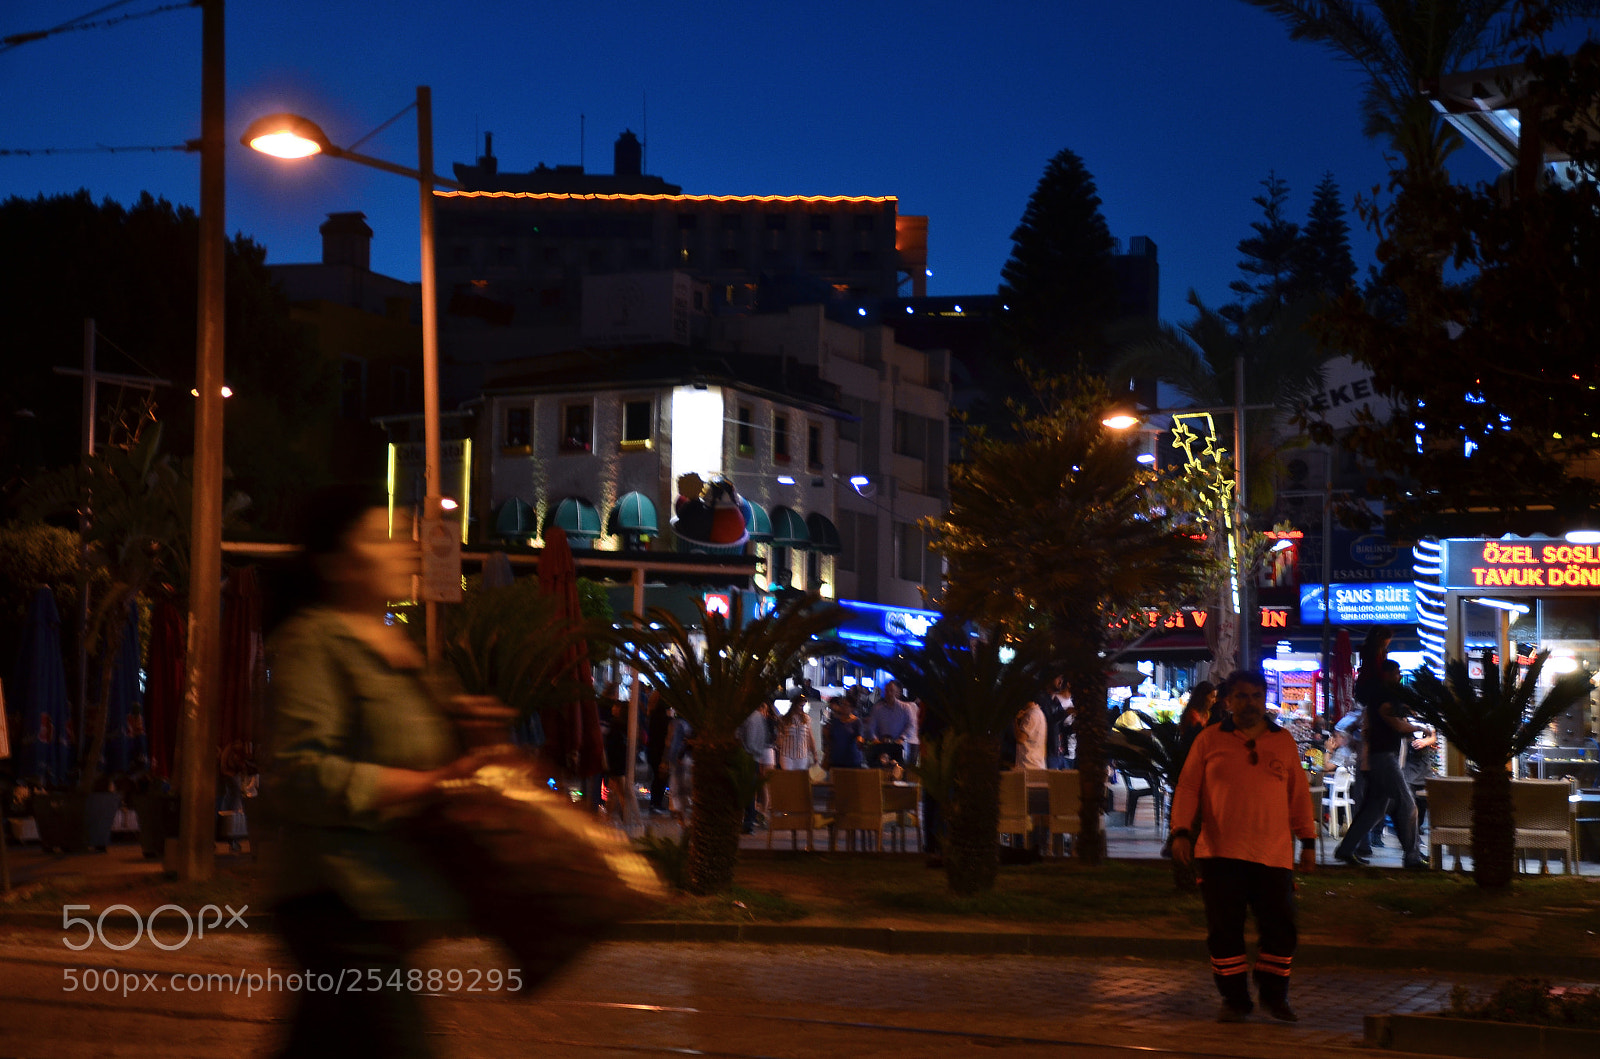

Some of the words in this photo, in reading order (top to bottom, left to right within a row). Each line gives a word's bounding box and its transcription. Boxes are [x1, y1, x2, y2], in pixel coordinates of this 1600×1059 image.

[1482, 541, 1540, 564] ÖZEL
[1542, 545, 1600, 564] SOSL
[1471, 567, 1546, 586] TAVUK
[1375, 585, 1411, 602] BÜFE
